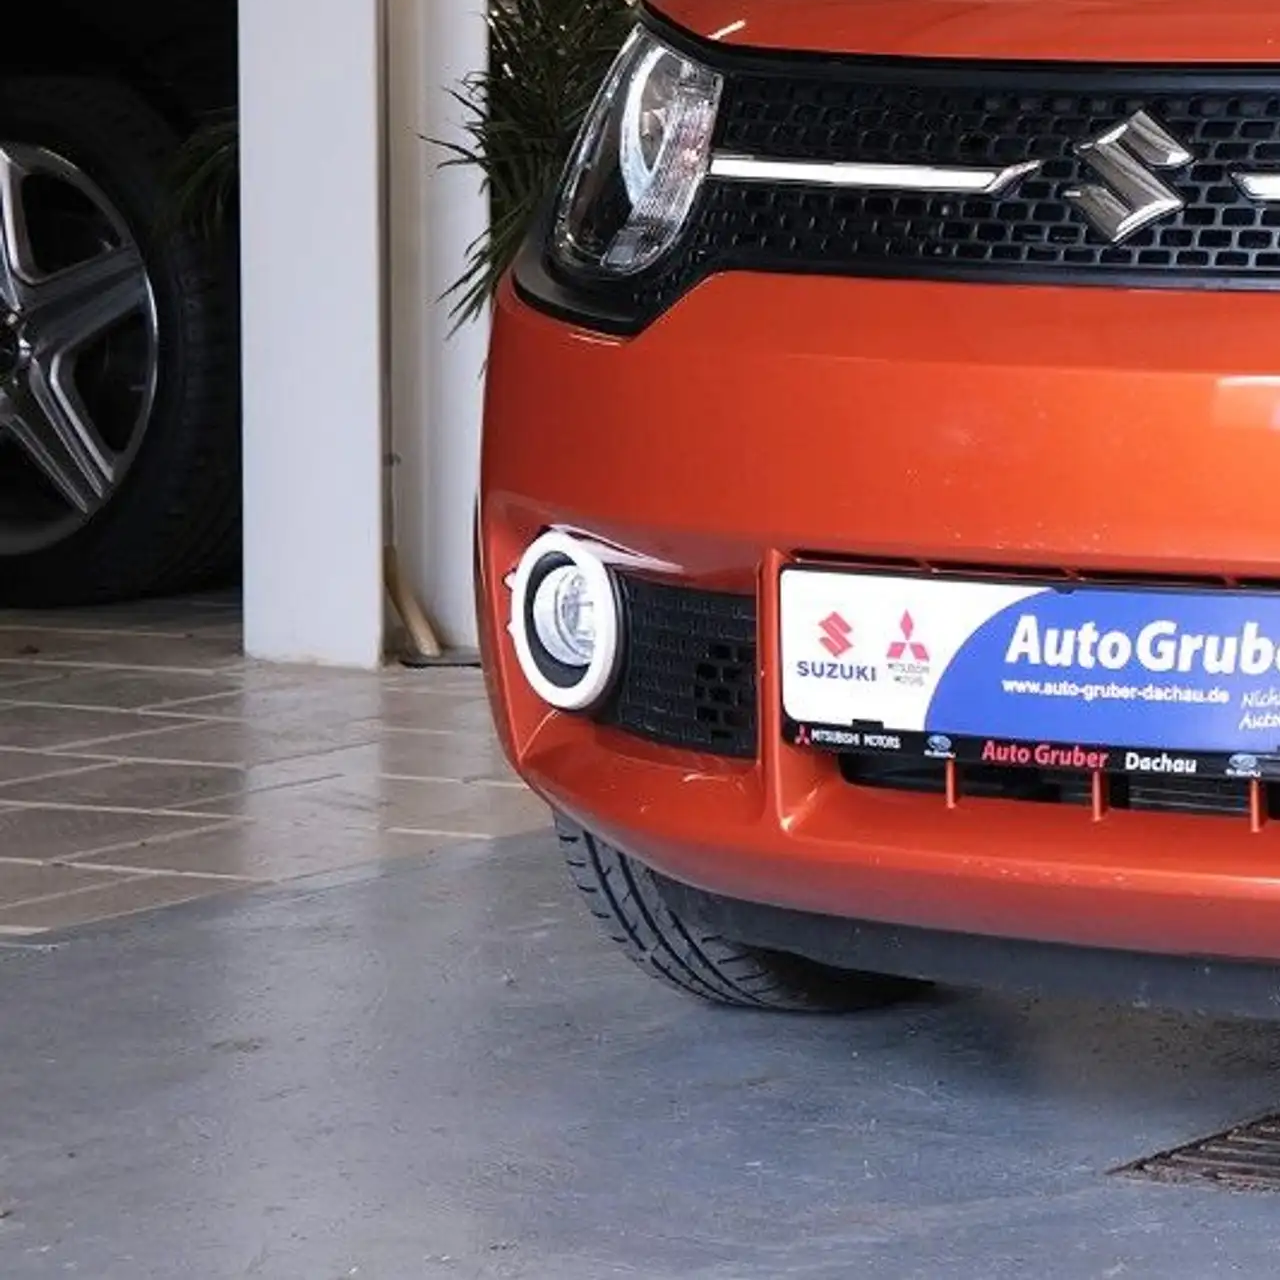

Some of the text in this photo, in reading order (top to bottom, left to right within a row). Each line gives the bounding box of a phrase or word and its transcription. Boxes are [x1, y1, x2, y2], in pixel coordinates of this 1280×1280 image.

[796, 660, 877, 682] SUZUKI
[1002, 679, 1230, 704] www.auto-gruber-dachau.de
[981, 739, 1198, 773] Auto Gruber Dachau
